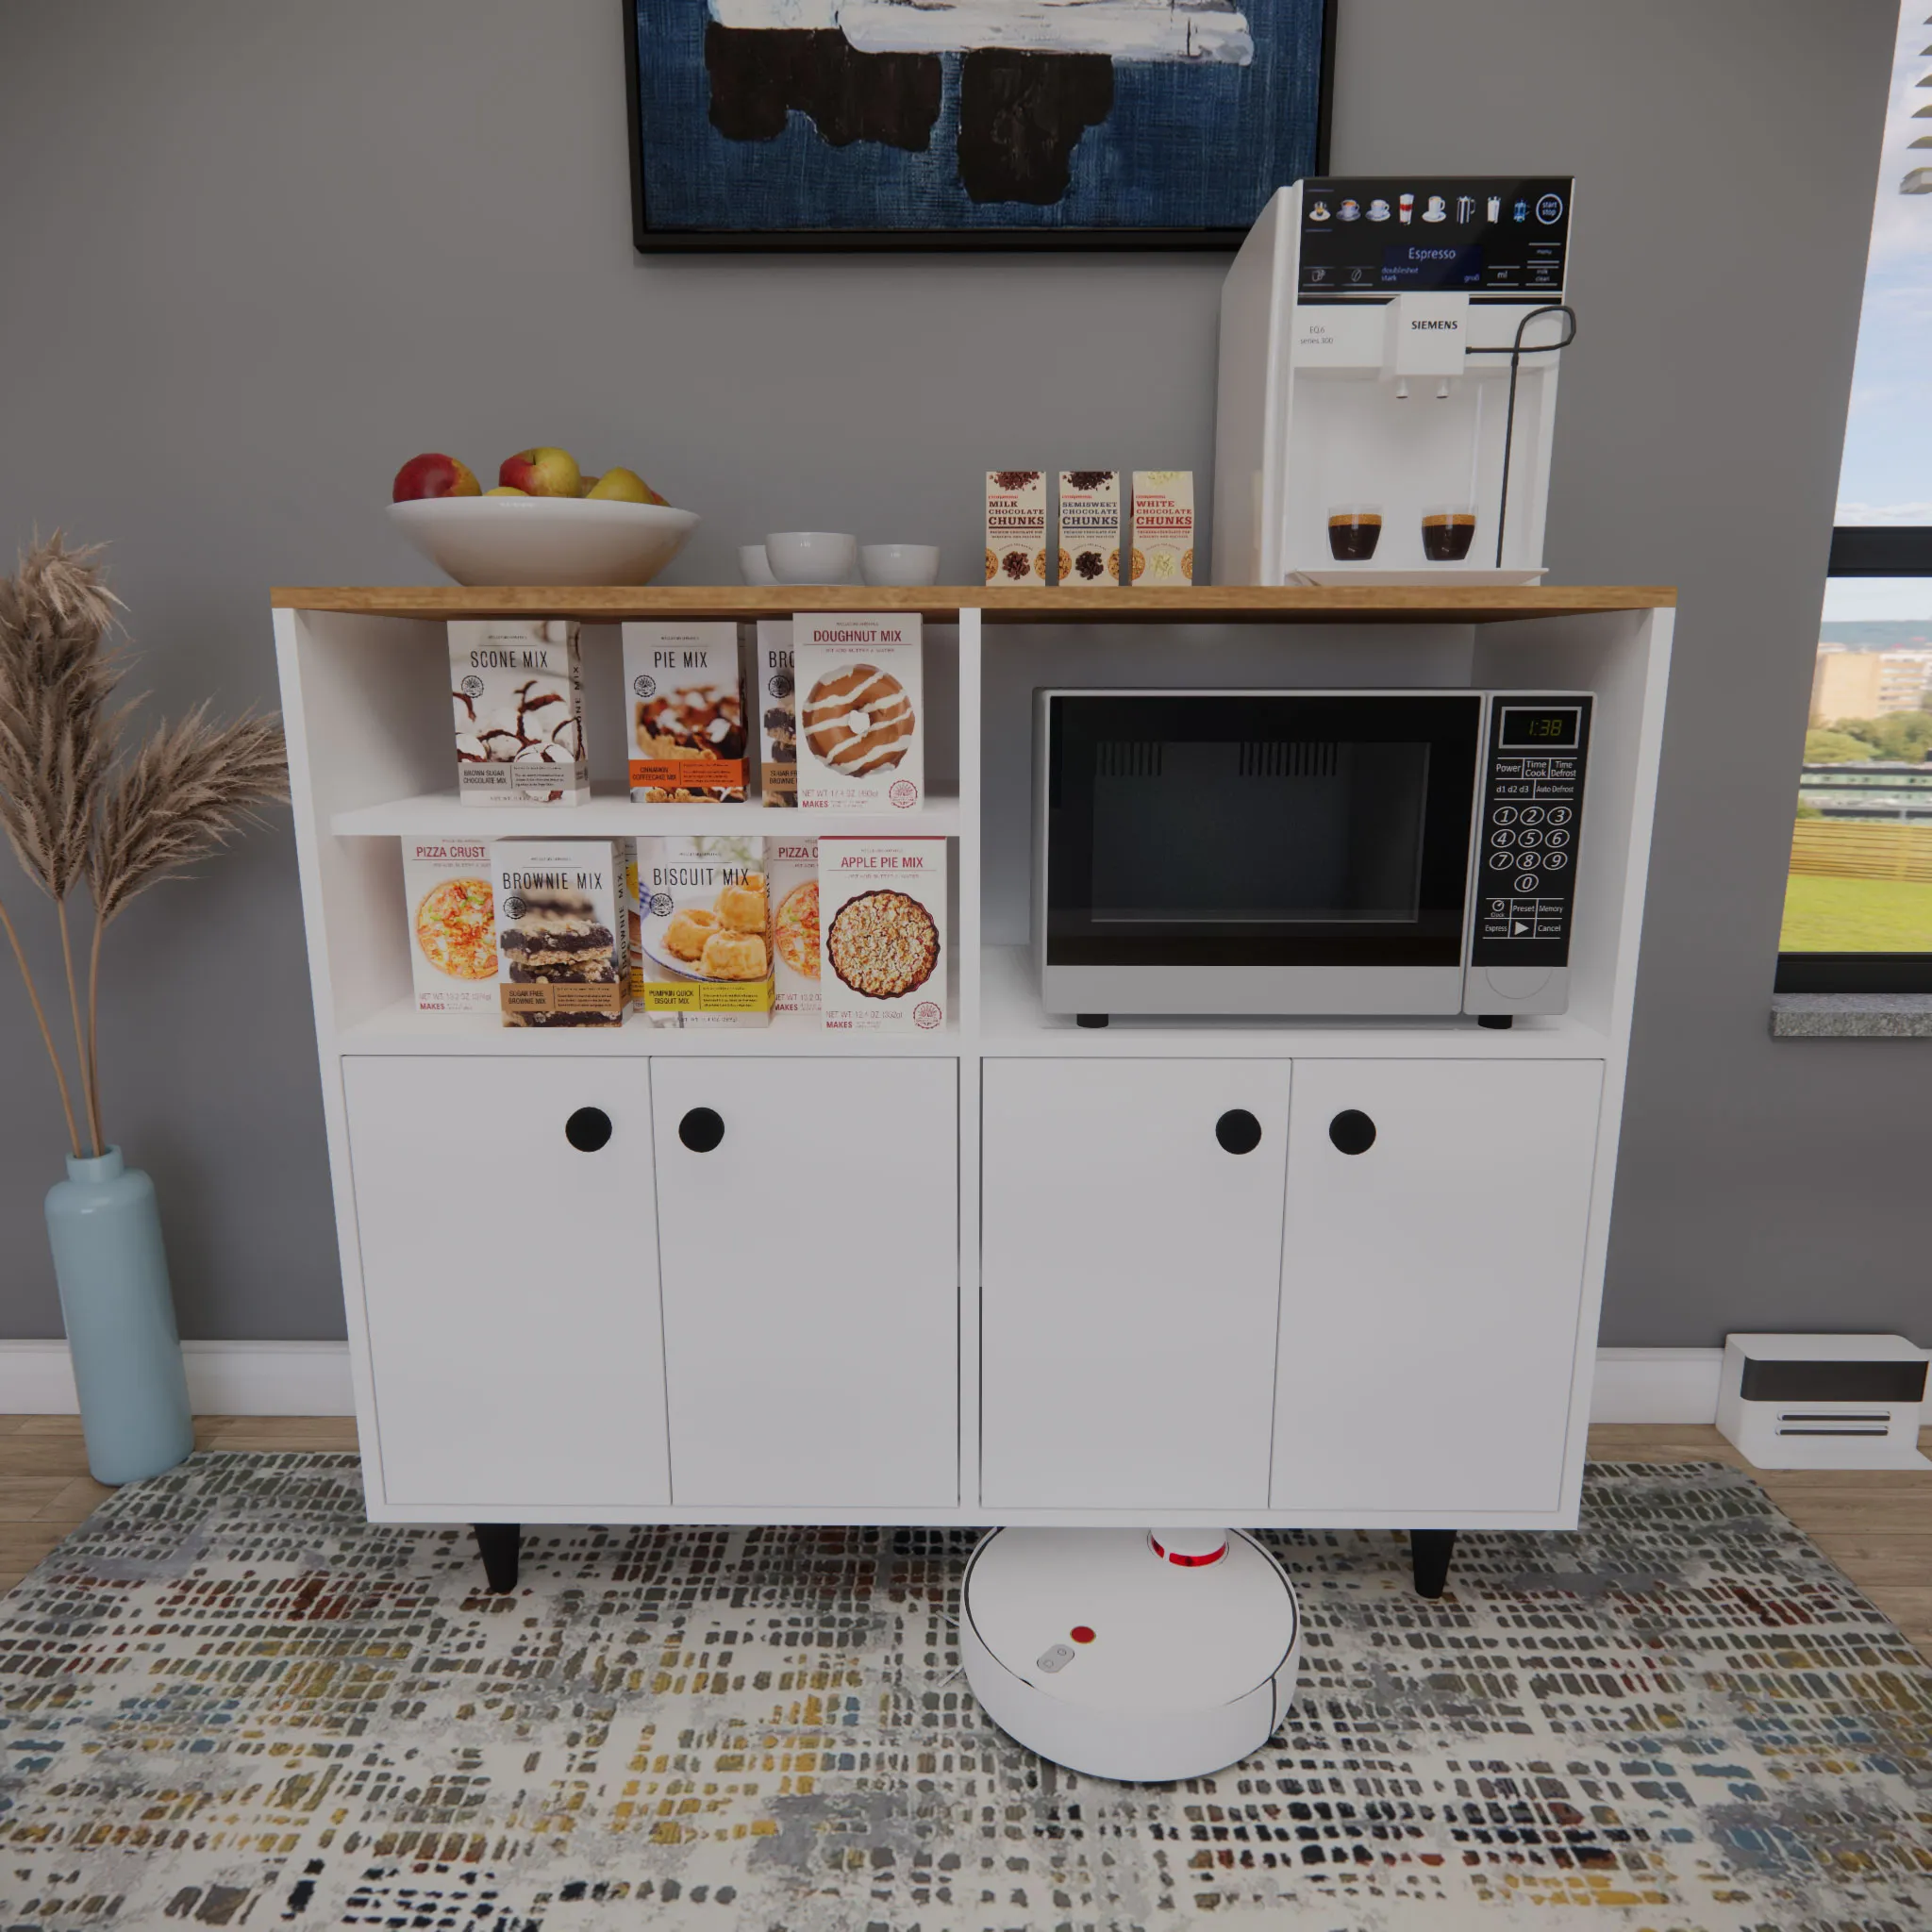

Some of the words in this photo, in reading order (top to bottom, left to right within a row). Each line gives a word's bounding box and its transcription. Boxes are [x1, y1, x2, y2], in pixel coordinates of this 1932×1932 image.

[1408, 247, 1457, 261] Espresso
[1381, 266, 1419, 275] doubleshot
[1496, 271, 1507, 279] ml
[1411, 321, 1458, 330] SIEMENS
[989, 516, 1044, 525] CHUNKS
[1062, 516, 1119, 525] CHUNKS
[1136, 516, 1192, 525] CHUNKS
[813, 630, 877, 642] DOUGHNUT
[880, 630, 902, 642] MIX
[471, 651, 517, 668] SCONE
[523, 651, 548, 668] MIX
[654, 652, 675, 668] PIE
[683, 652, 708, 668] MIX
[1528, 719, 1563, 737] 1:38
[1496, 763, 1522, 773] Power
[1524, 769, 1547, 777] Cook
[1551, 769, 1577, 777] Defrost
[1496, 785, 1506, 793] d1
[1507, 785, 1518, 793] d2
[1519, 785, 1529, 793] d3
[1536, 785, 1552, 793] Auto
[1552, 785, 1574, 793] Defrost
[802, 800, 828, 808] MAKES
[1501, 809, 1509, 823] 1
[1526, 809, 1538, 823] 2
[1555, 809, 1565, 823] 3
[1497, 832, 1507, 845] 4
[1524, 832, 1536, 845] 5
[1552, 832, 1562, 845] 6
[416, 847, 447, 858] PIZZA
[449, 847, 486, 858] CRUST
[778, 847, 809, 858] PIZZA
[841, 857, 877, 868] APPLE
[881, 857, 898, 868] PIE
[902, 857, 924, 868] MIX
[1497, 855, 1507, 867] 7
[1523, 855, 1533, 868] 8
[1551, 855, 1561, 868] 9
[503, 873, 568, 890] BROWNIE
[577, 873, 603, 890] MIX
[653, 868, 714, 886] BISCUIT
[723, 868, 750, 886] MIX
[1522, 876, 1532, 890] 0
[1512, 905, 1536, 913] Preset
[1539, 906, 1564, 914] Memory
[1485, 924, 1507, 933] Express
